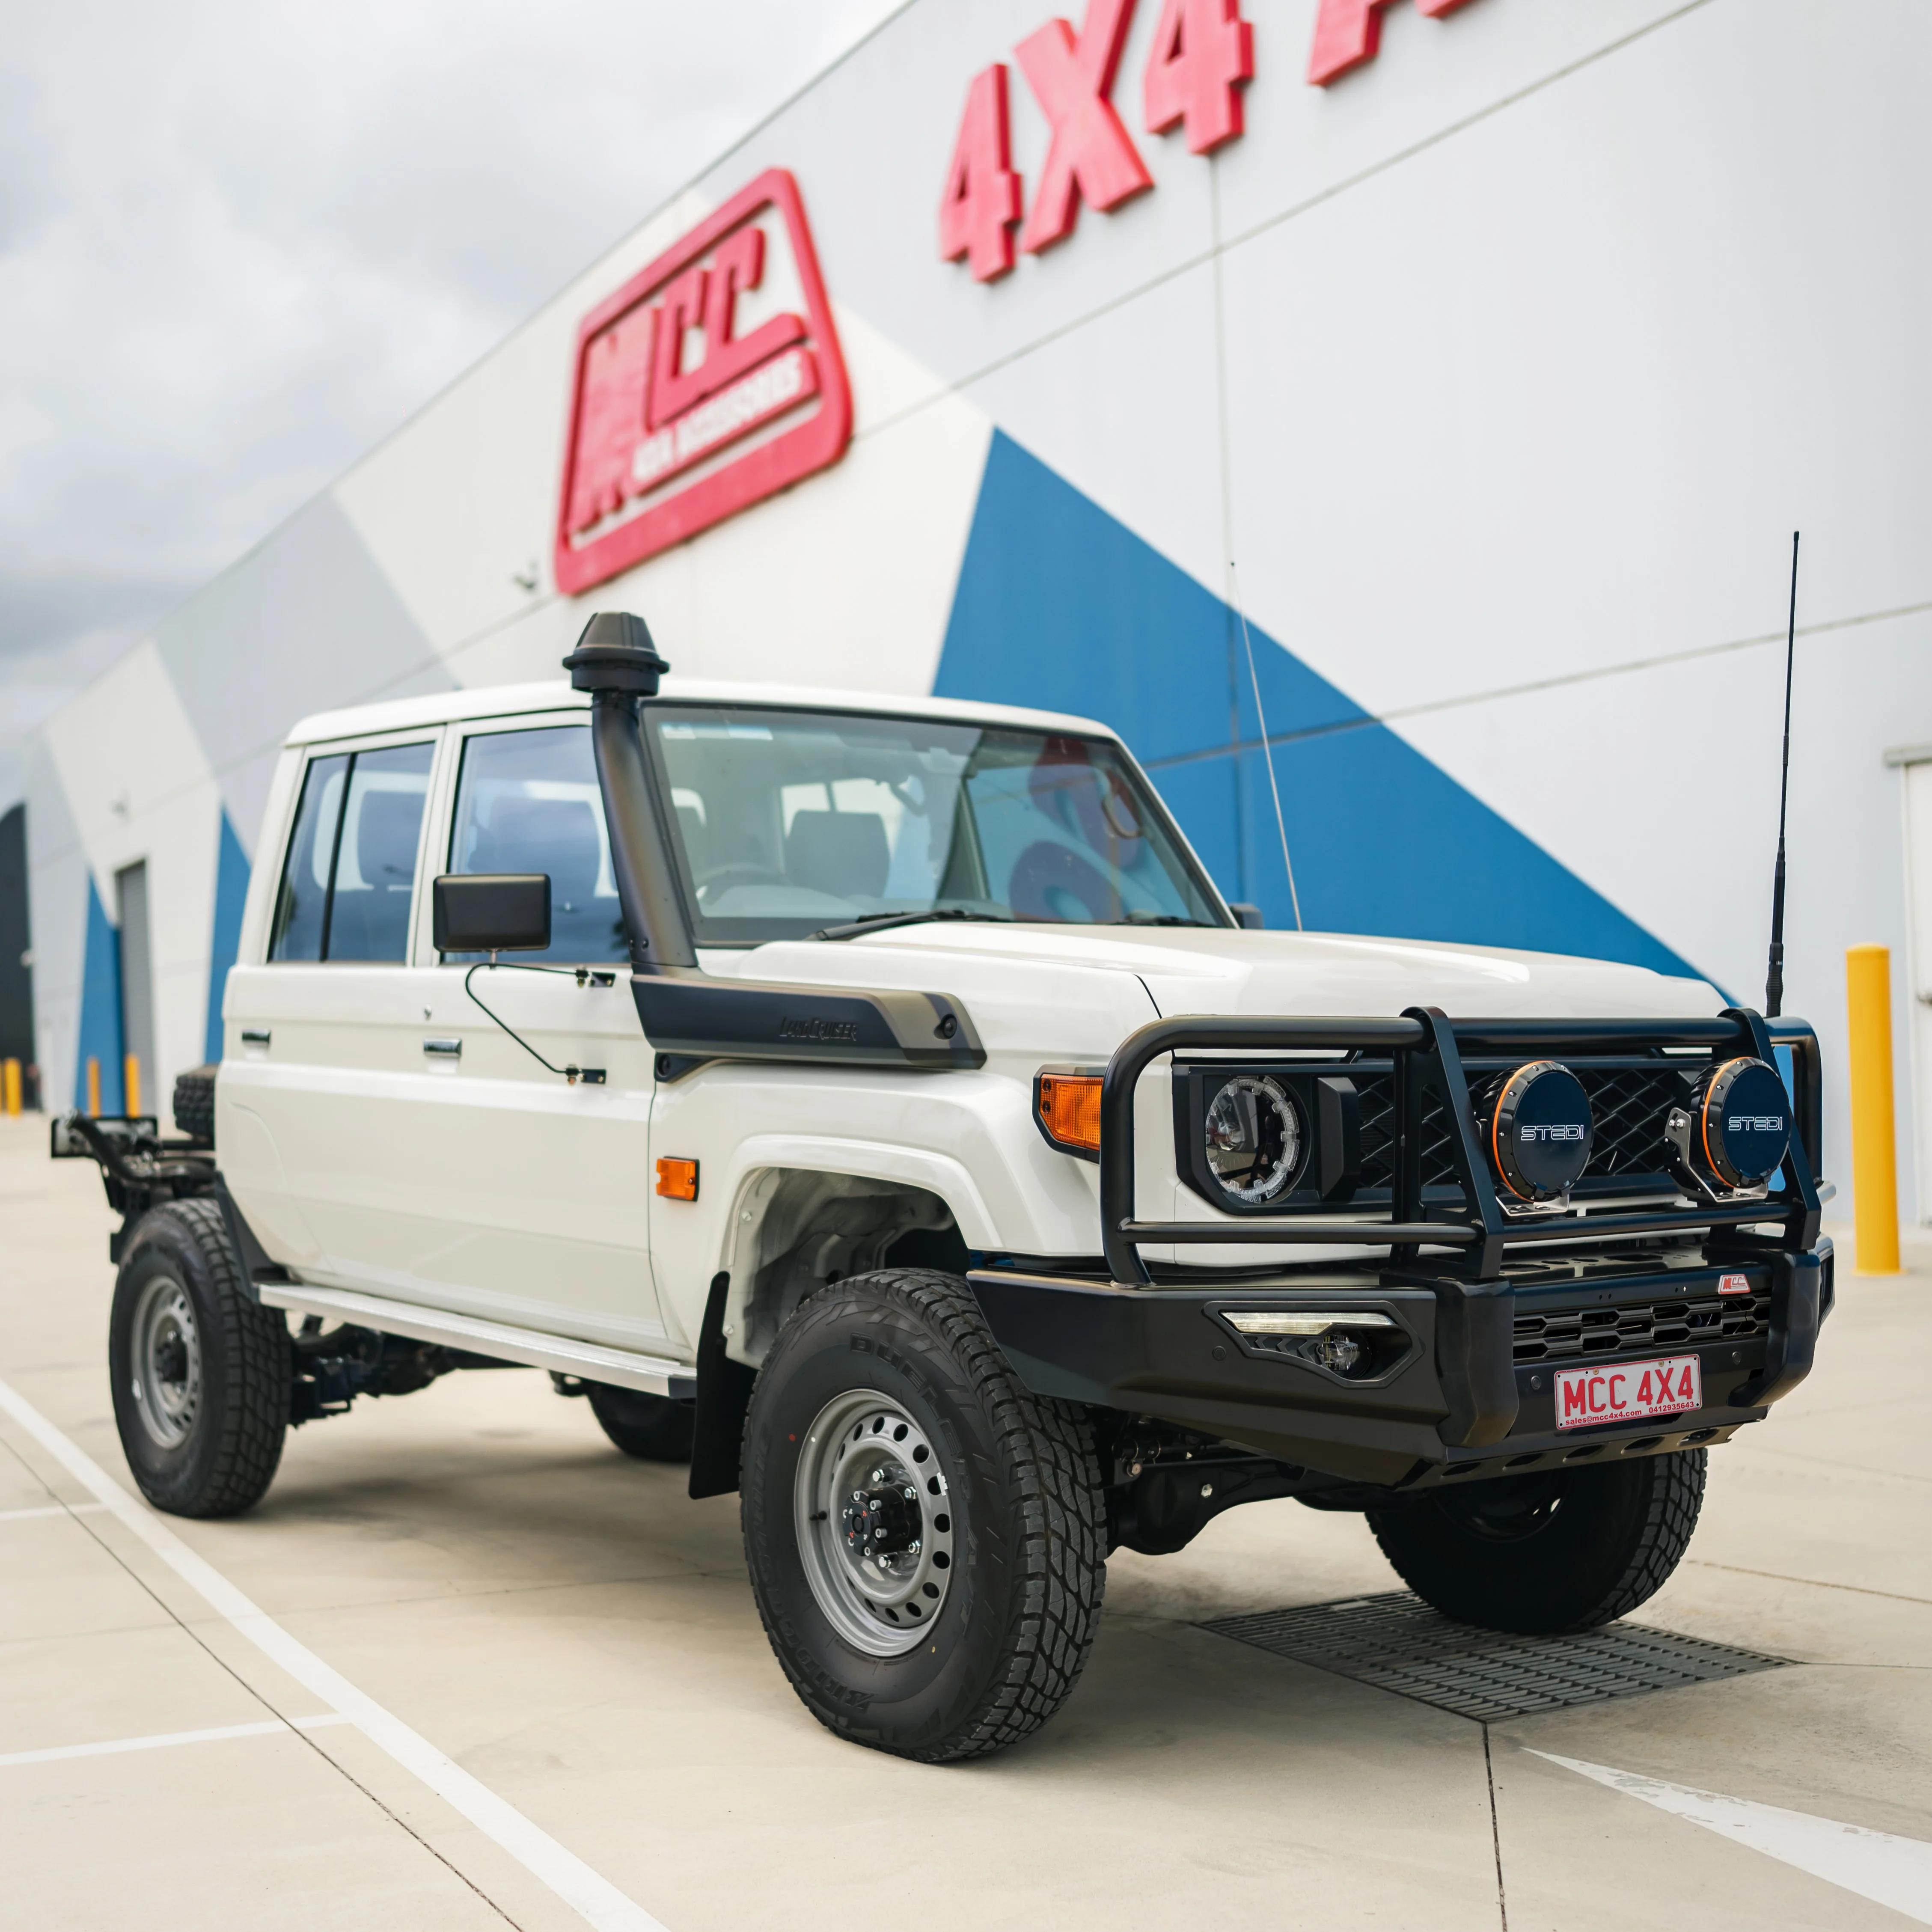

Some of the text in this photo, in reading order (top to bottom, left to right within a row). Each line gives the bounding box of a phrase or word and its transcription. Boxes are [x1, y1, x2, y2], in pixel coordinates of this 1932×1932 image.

[938, 0, 1255, 284] 4X4
[566, 226, 807, 533] MCC
[1521, 1124, 1584, 1141] STEDI
[1728, 1116, 1783, 1131] STEDI
[1723, 1277, 1745, 1290] MCC
[1563, 1365, 1693, 1417] MCC 4X4
[849, 1331, 974, 1503] DUELER
[1565, 1401, 1694, 1425] sales@mcc4x4.com 0412935643
